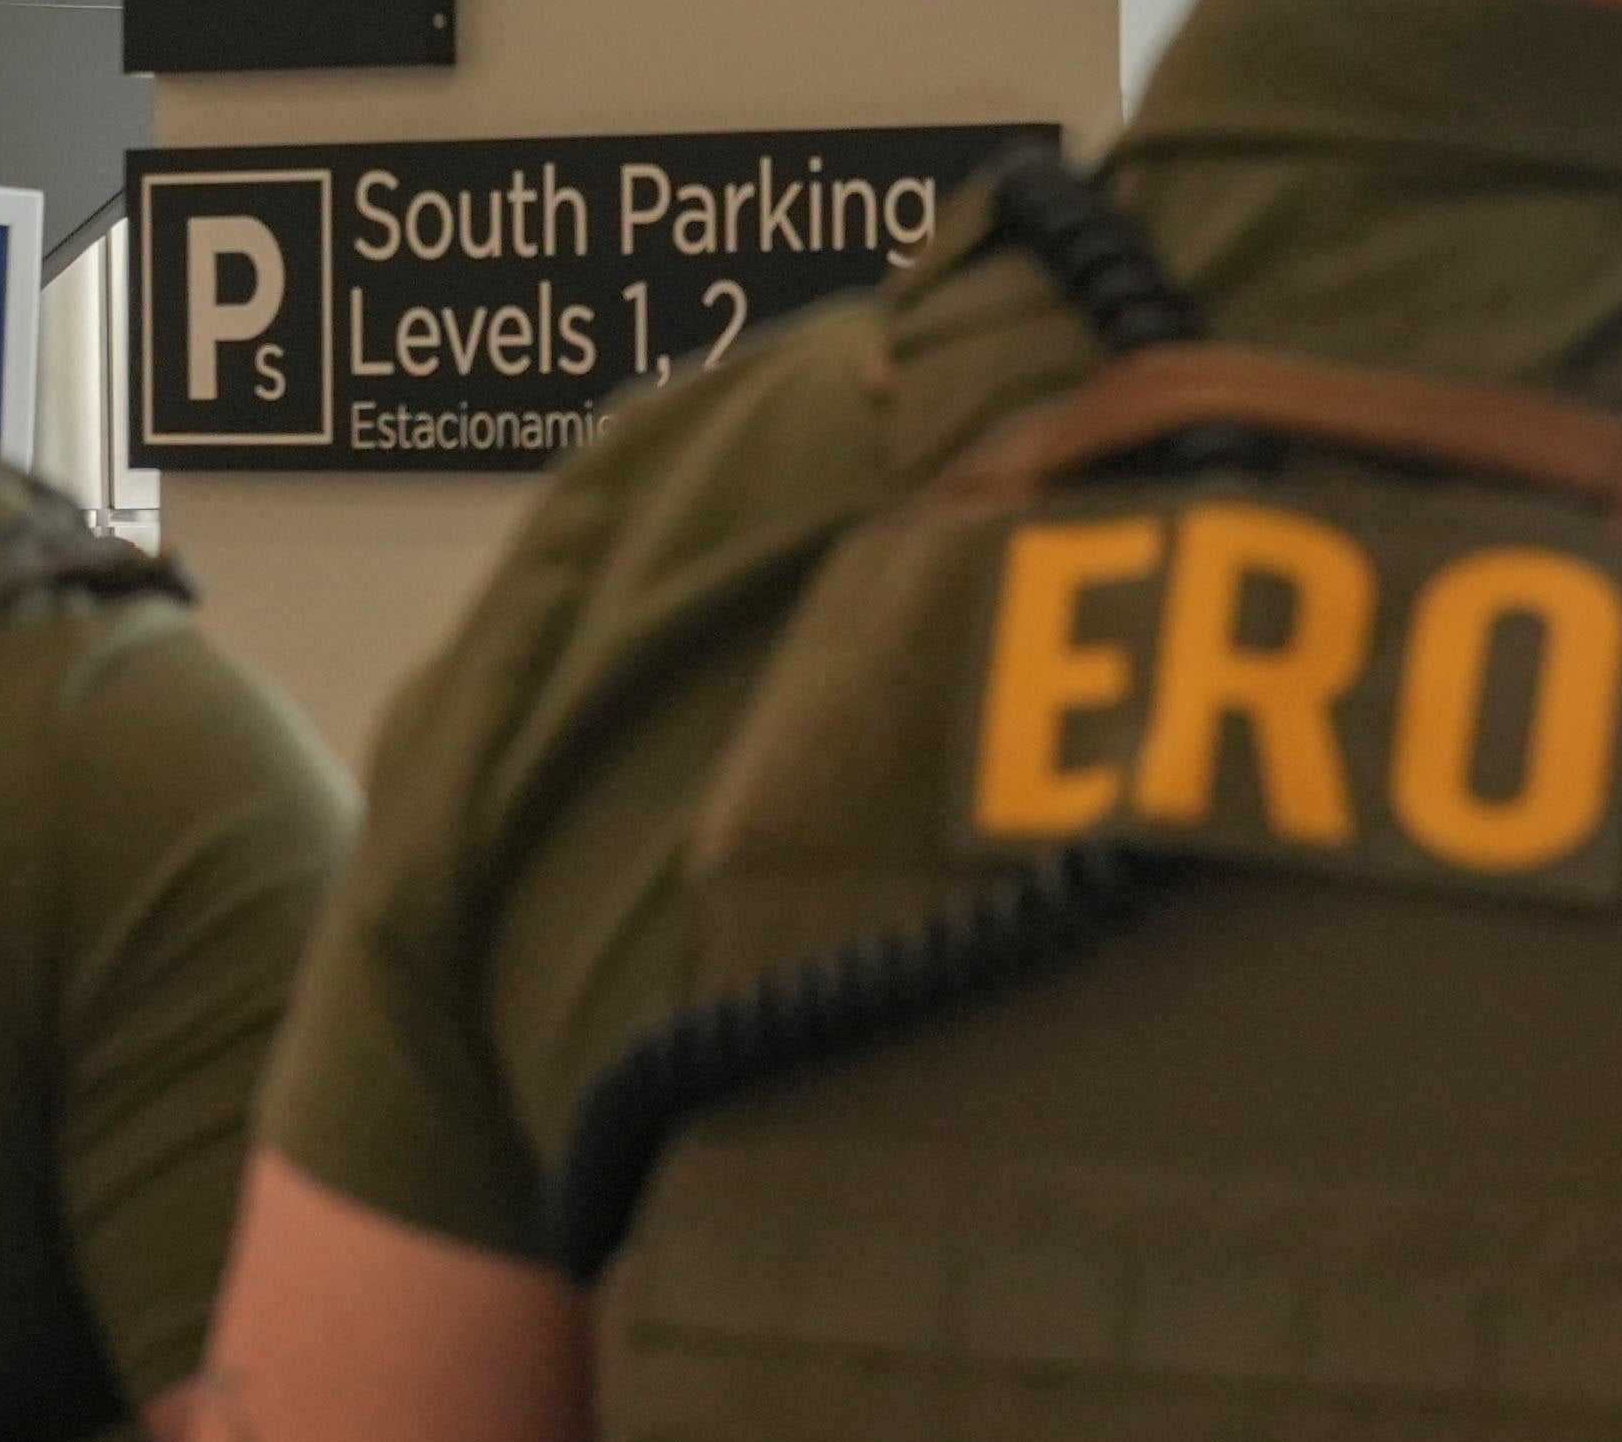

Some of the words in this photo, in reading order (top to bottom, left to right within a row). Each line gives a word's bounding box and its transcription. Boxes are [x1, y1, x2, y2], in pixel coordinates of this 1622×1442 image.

[353, 161, 589, 264] South
[620, 155, 936, 269] Parking
[349, 280, 597, 377] Levels
[621, 279, 671, 389] 1,
[701, 278, 748, 374] 2
